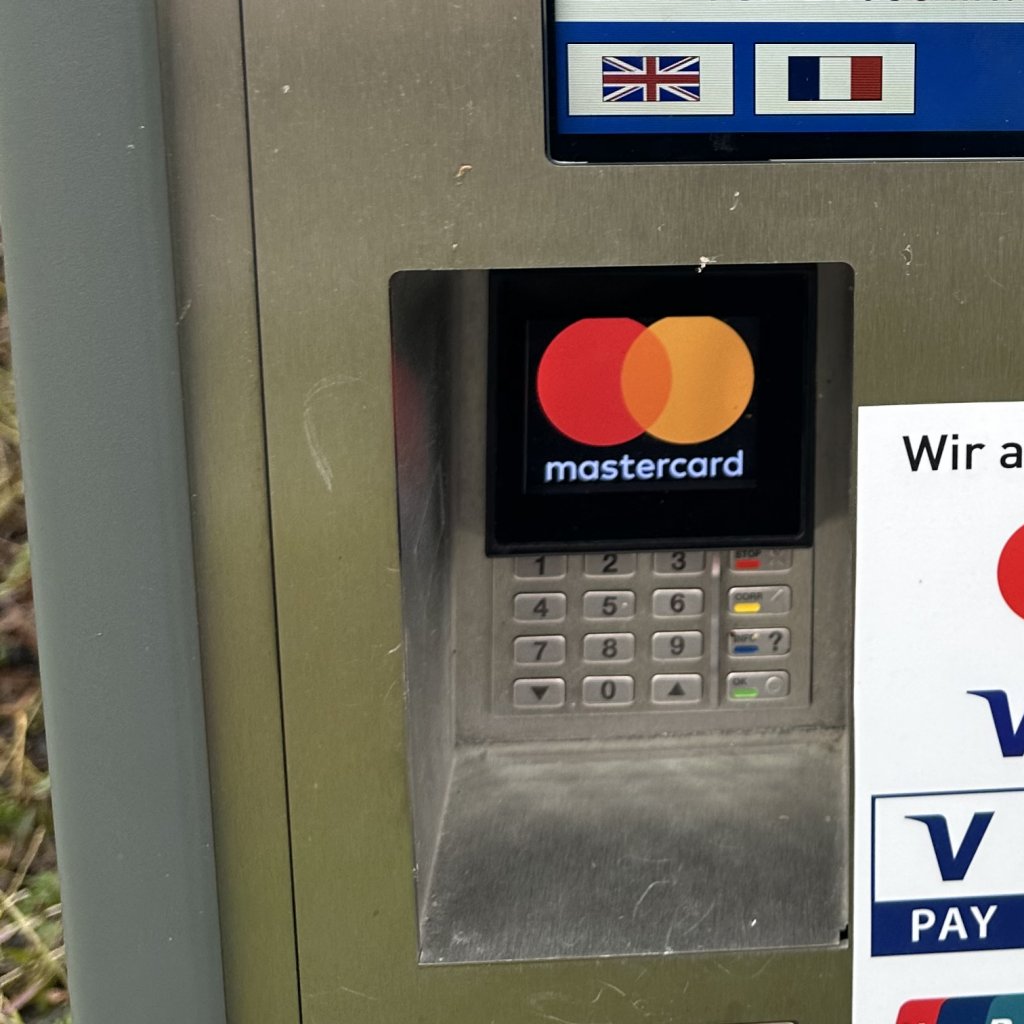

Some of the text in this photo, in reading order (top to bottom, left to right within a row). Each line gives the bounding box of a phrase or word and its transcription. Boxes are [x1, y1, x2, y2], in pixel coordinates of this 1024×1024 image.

[545, 449, 744, 482] mastercard
[902, 433, 986, 472] Wir
[535, 552, 686, 575] 1 2 3
[533, 594, 685, 616] 4 5 6
[534, 636, 685, 660] 7 8 9
[601, 681, 615, 699] 0
[904, 811, 995, 882] V
[911, 904, 998, 943] PAY
